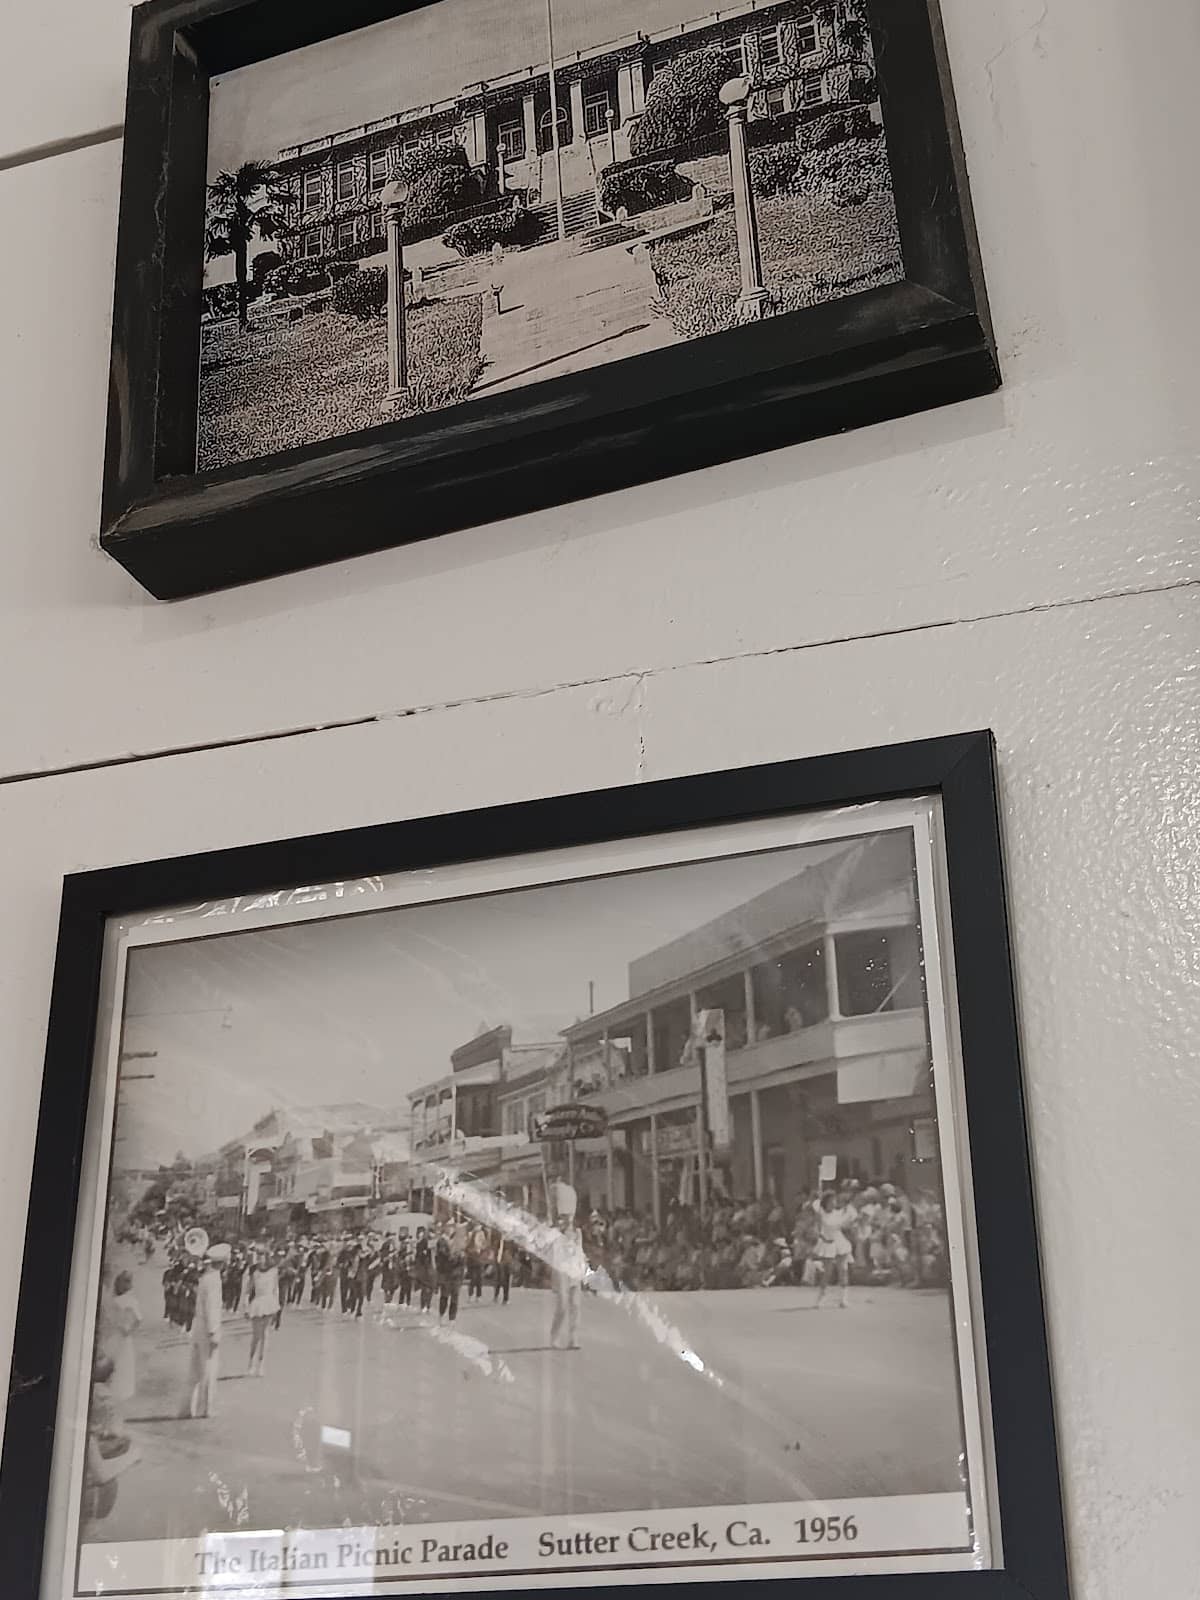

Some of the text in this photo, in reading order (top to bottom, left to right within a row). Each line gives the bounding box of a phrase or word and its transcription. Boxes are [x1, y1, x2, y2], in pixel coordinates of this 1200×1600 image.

[194, 1515, 859, 1576] The Italian Picnic Parade Sutter Creek, Ca. 1956
